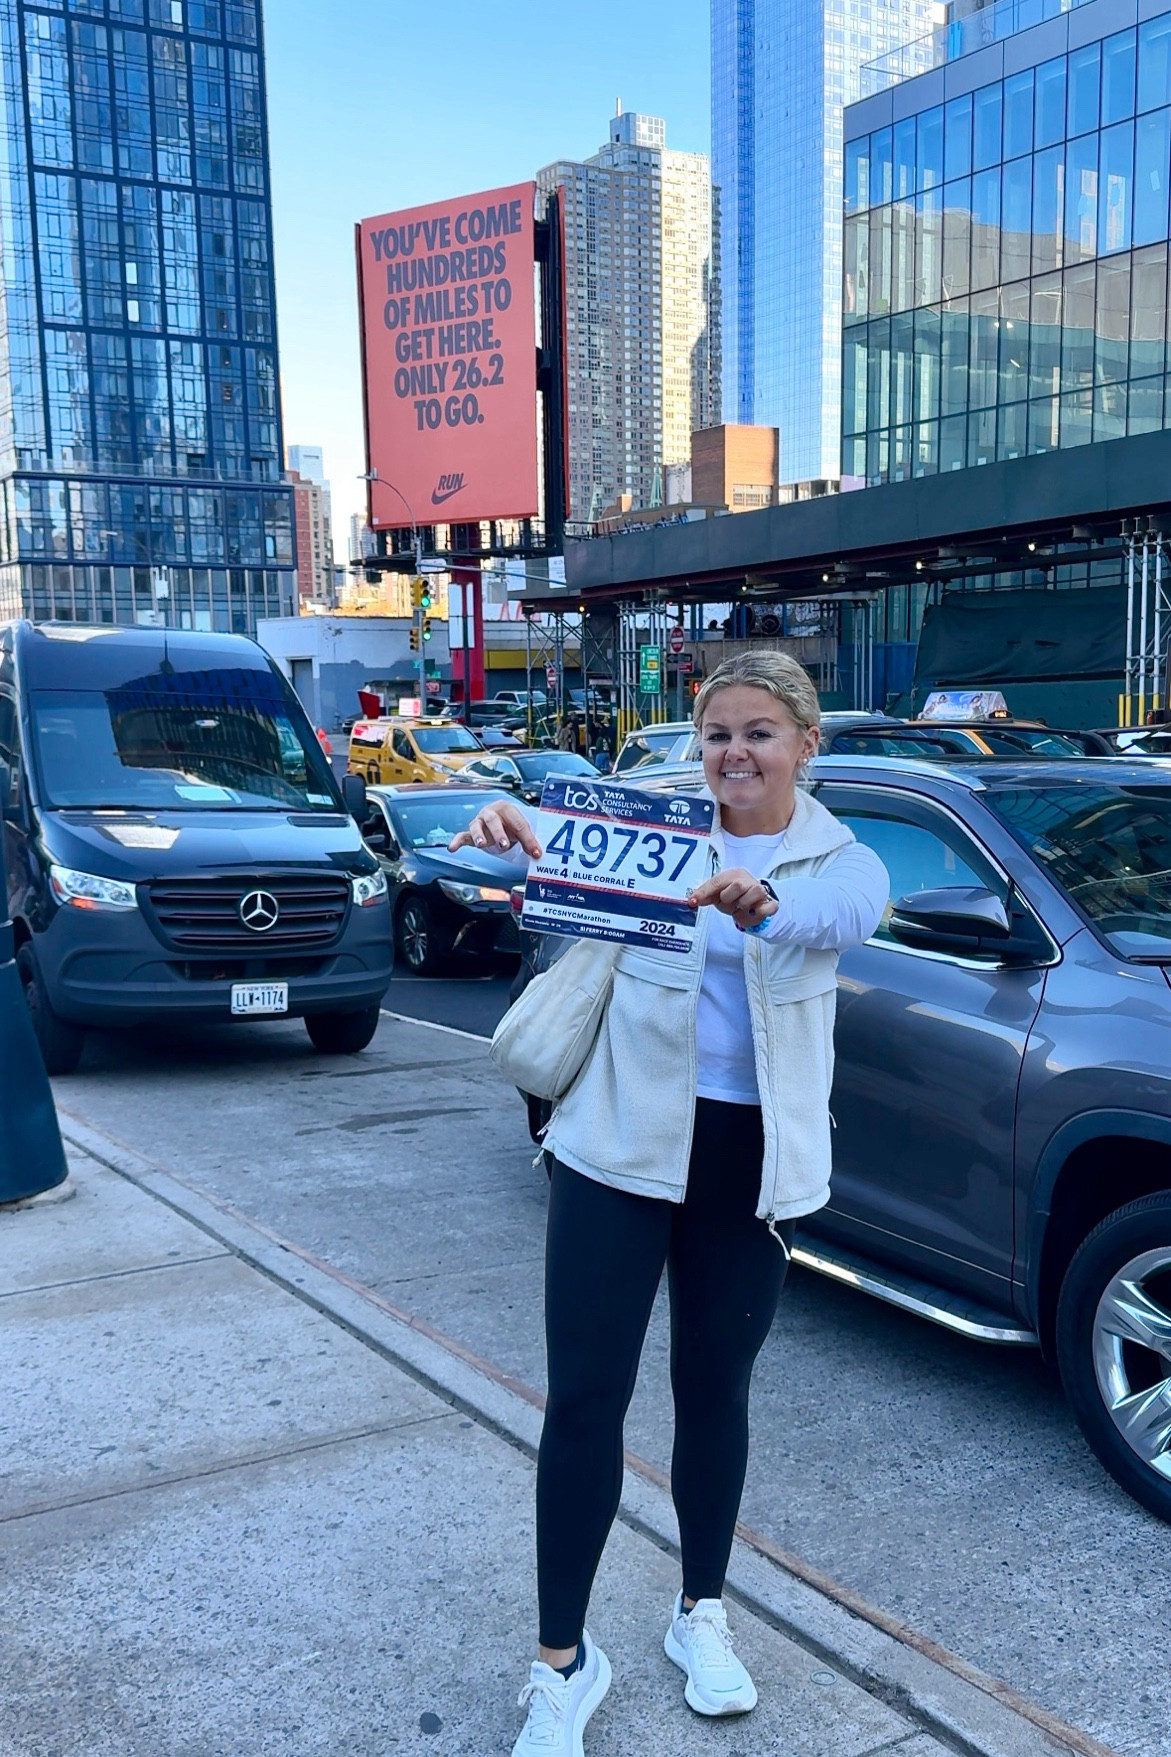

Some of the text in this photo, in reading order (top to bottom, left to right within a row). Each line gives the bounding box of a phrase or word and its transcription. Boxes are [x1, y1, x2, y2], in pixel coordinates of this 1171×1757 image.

[370, 199, 522, 262] YOU'VE COME
[386, 241, 506, 294] HUNDREDS
[384, 278, 512, 330] OF MILES TO
[395, 319, 501, 363] GET HERE.
[394, 354, 504, 399] ONLY 26.2
[414, 393, 485, 431] TO GO.
[438, 474, 464, 491] RUN
[564, 785, 599, 812] tcs
[602, 799, 653, 812] CONSULTANCY
[604, 791, 625, 800] TATA
[601, 806, 633, 817] SERVICES
[664, 814, 691, 826] TATA
[546, 820, 698, 882] 49737
[536, 865, 636, 889] WAVE 4 BLUE CORRAL E
[543, 907, 611, 925] #TCSNYCMarathon
[639, 920, 676, 937] 2024
